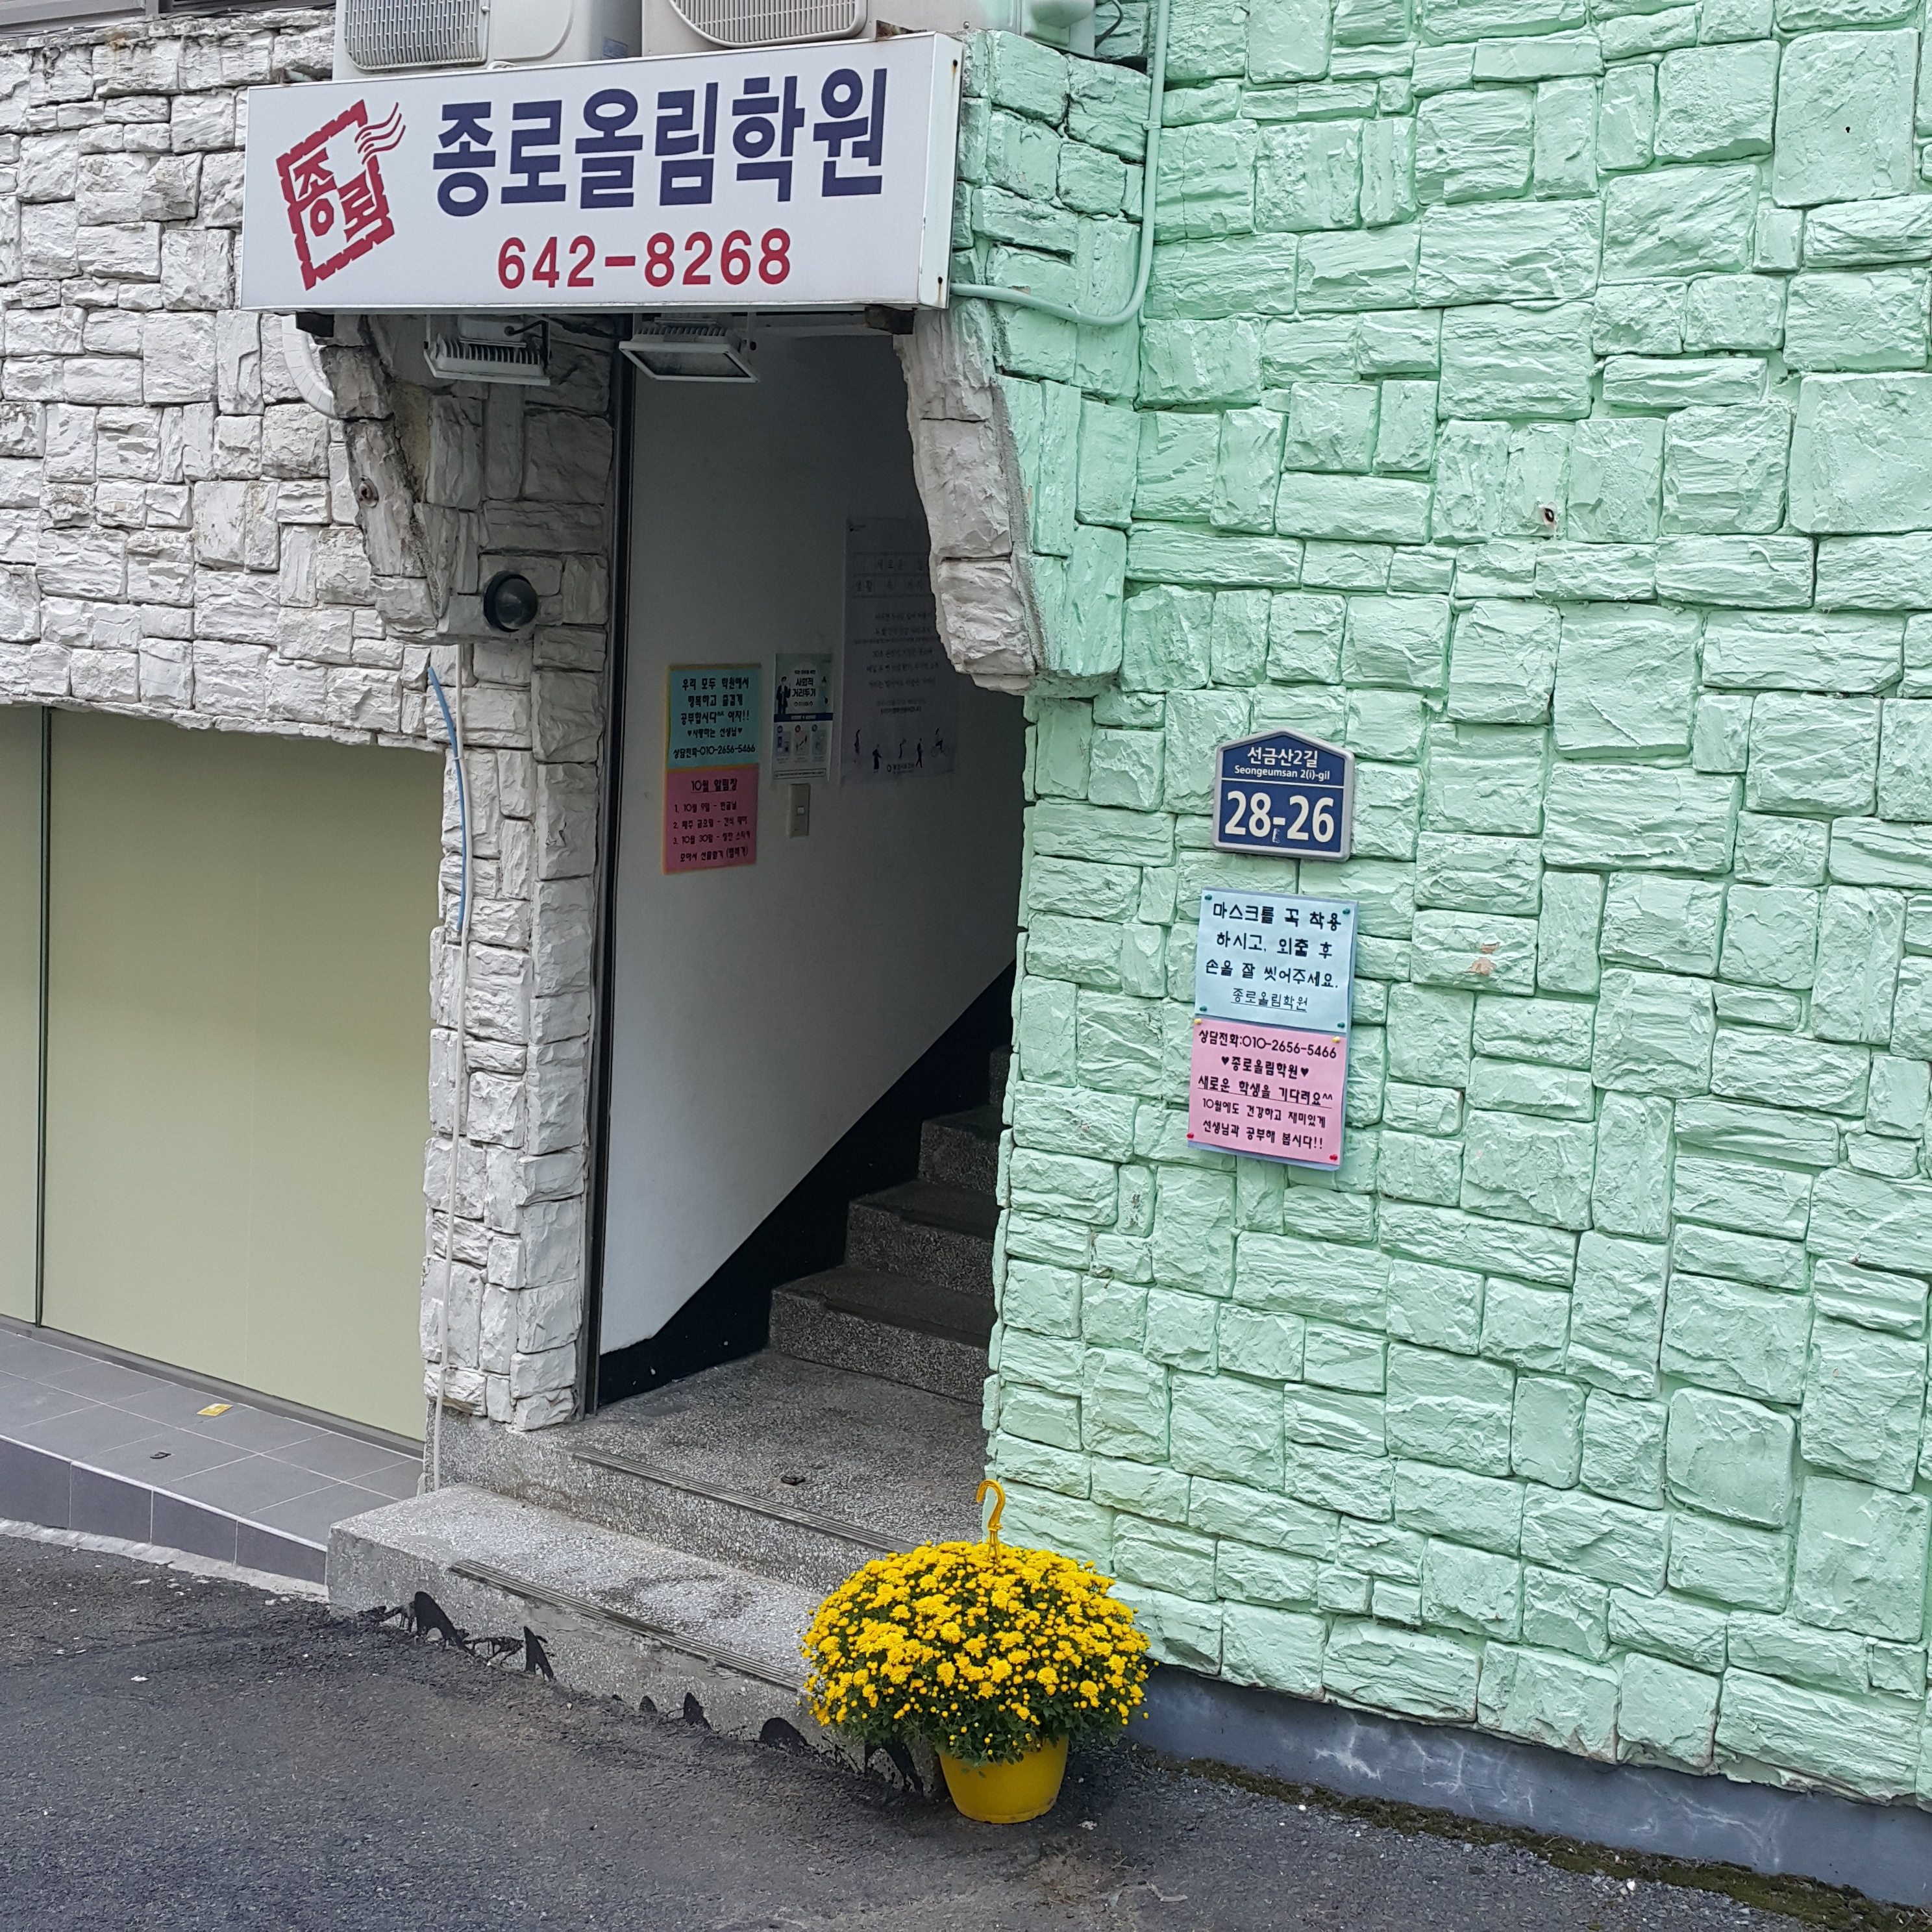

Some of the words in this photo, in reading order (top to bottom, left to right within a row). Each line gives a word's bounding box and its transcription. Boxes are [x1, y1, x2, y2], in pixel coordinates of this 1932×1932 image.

[433, 68, 887, 217] 종로올림학원
[497, 228, 792, 290] 642-8268
[682, 678, 697, 691] 우리
[701, 677, 716, 690] 모두
[721, 677, 749, 690] 학원에서
[791, 688, 816, 697] 거리두기
[687, 694, 717, 708] 행복하고
[1247, 746, 1318, 768] 선금산2길
[691, 779, 709, 793] 10월
[713, 778, 737, 792] 알림장
[1234, 765, 1298, 778] Seongeumsan
[1300, 769, 1330, 782] 2(i)-gil
[1224, 790, 1335, 843] 28-26
[1213, 901, 1274, 924] 마스크를
[1309, 911, 1341, 932] 착용
[1216, 930, 1267, 952] 하시고,
[1276, 937, 1309, 958] 외출
[1319, 941, 1333, 959] 후
[1206, 958, 1233, 977] 손을
[1242, 962, 1256, 979] 잘
[1263, 965, 1338, 988] 씻어주세요.
[1232, 987, 1308, 1011] 종로올림학원
[1198, 1029, 1337, 1059] 상담전화:010-2656-5466
[1231, 1056, 1298, 1080] 종로올림학원
[1198, 1075, 1230, 1093] 새로운
[1239, 1080, 1271, 1099] 학생을
[1278, 1086, 1333, 1106] 기다려요^^
[1202, 1098, 1239, 1115] 10월에도
[1246, 1104, 1282, 1121] 건강하고
[1287, 1111, 1326, 1128] 재미있게
[1202, 1119, 1240, 1137] 선생님과
[1246, 1126, 1276, 1143] 공부해
[1282, 1132, 1323, 1150] 봅시다!!
